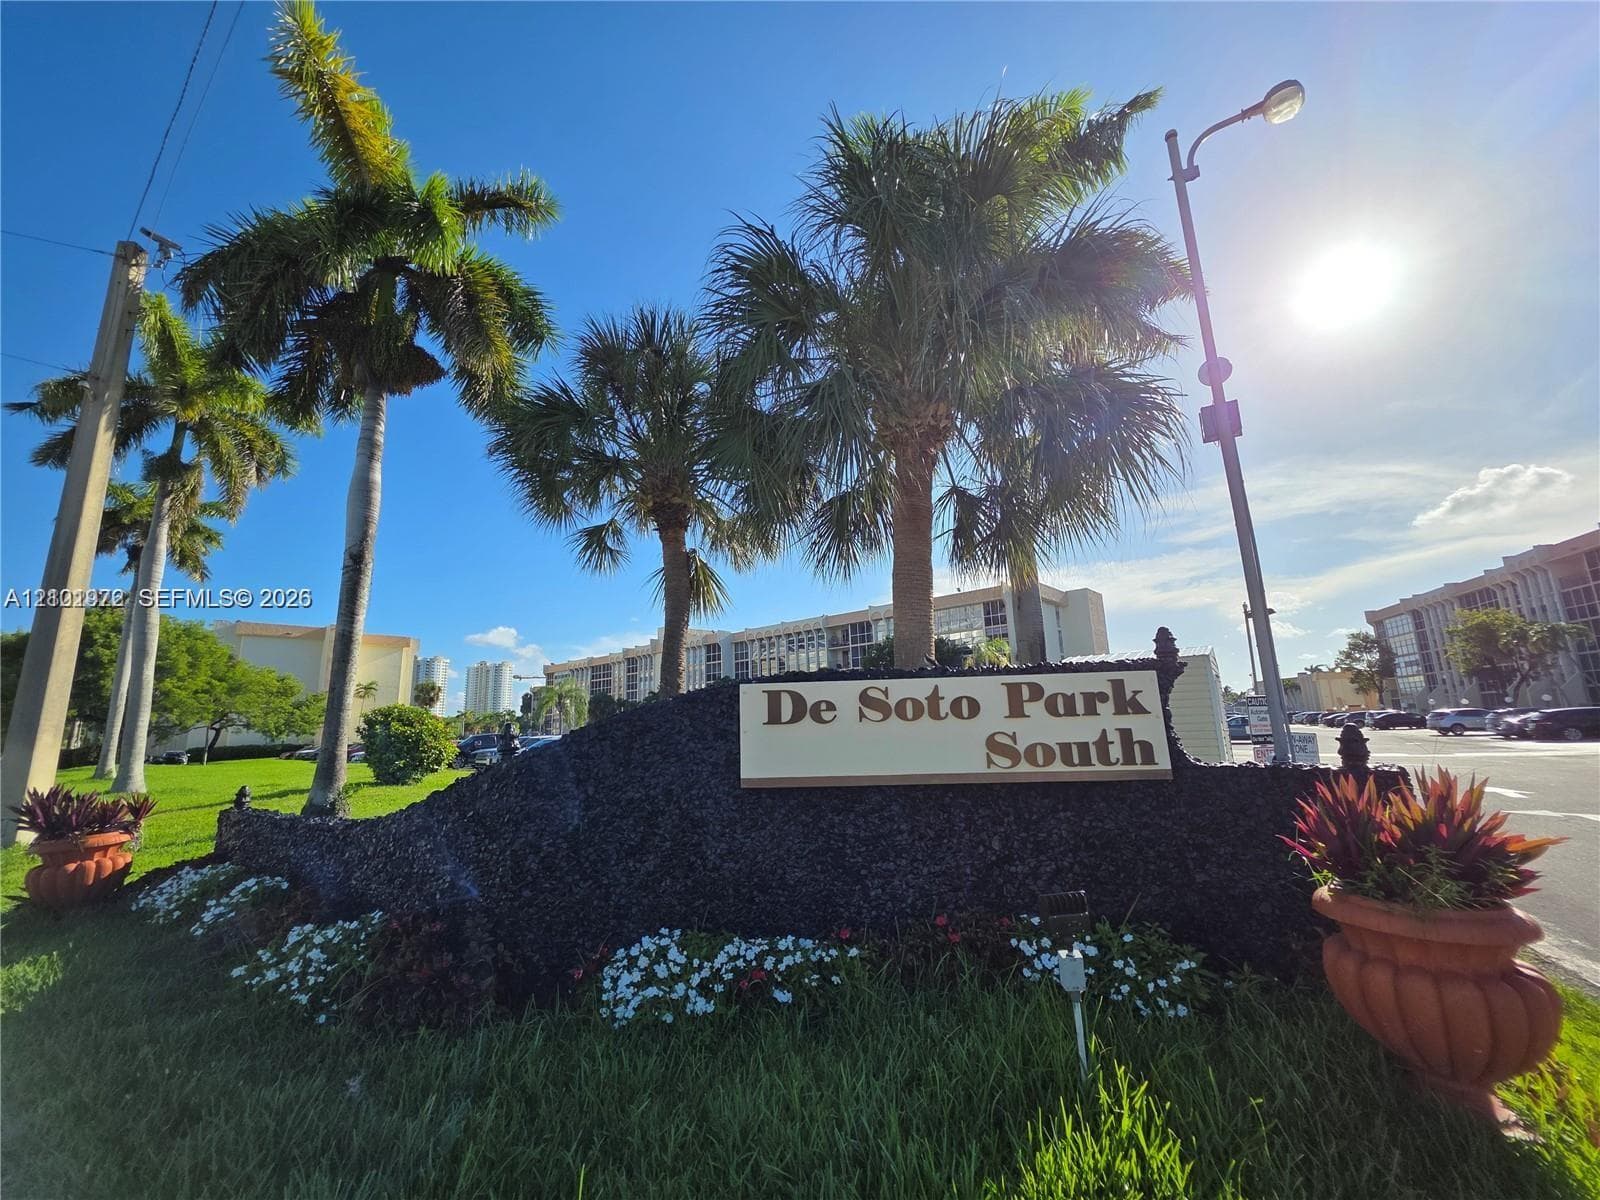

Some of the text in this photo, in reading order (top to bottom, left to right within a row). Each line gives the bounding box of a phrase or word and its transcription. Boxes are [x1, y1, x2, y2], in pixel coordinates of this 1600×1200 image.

[762, 678, 1152, 726] De Soto Park
[985, 727, 1160, 770] South
